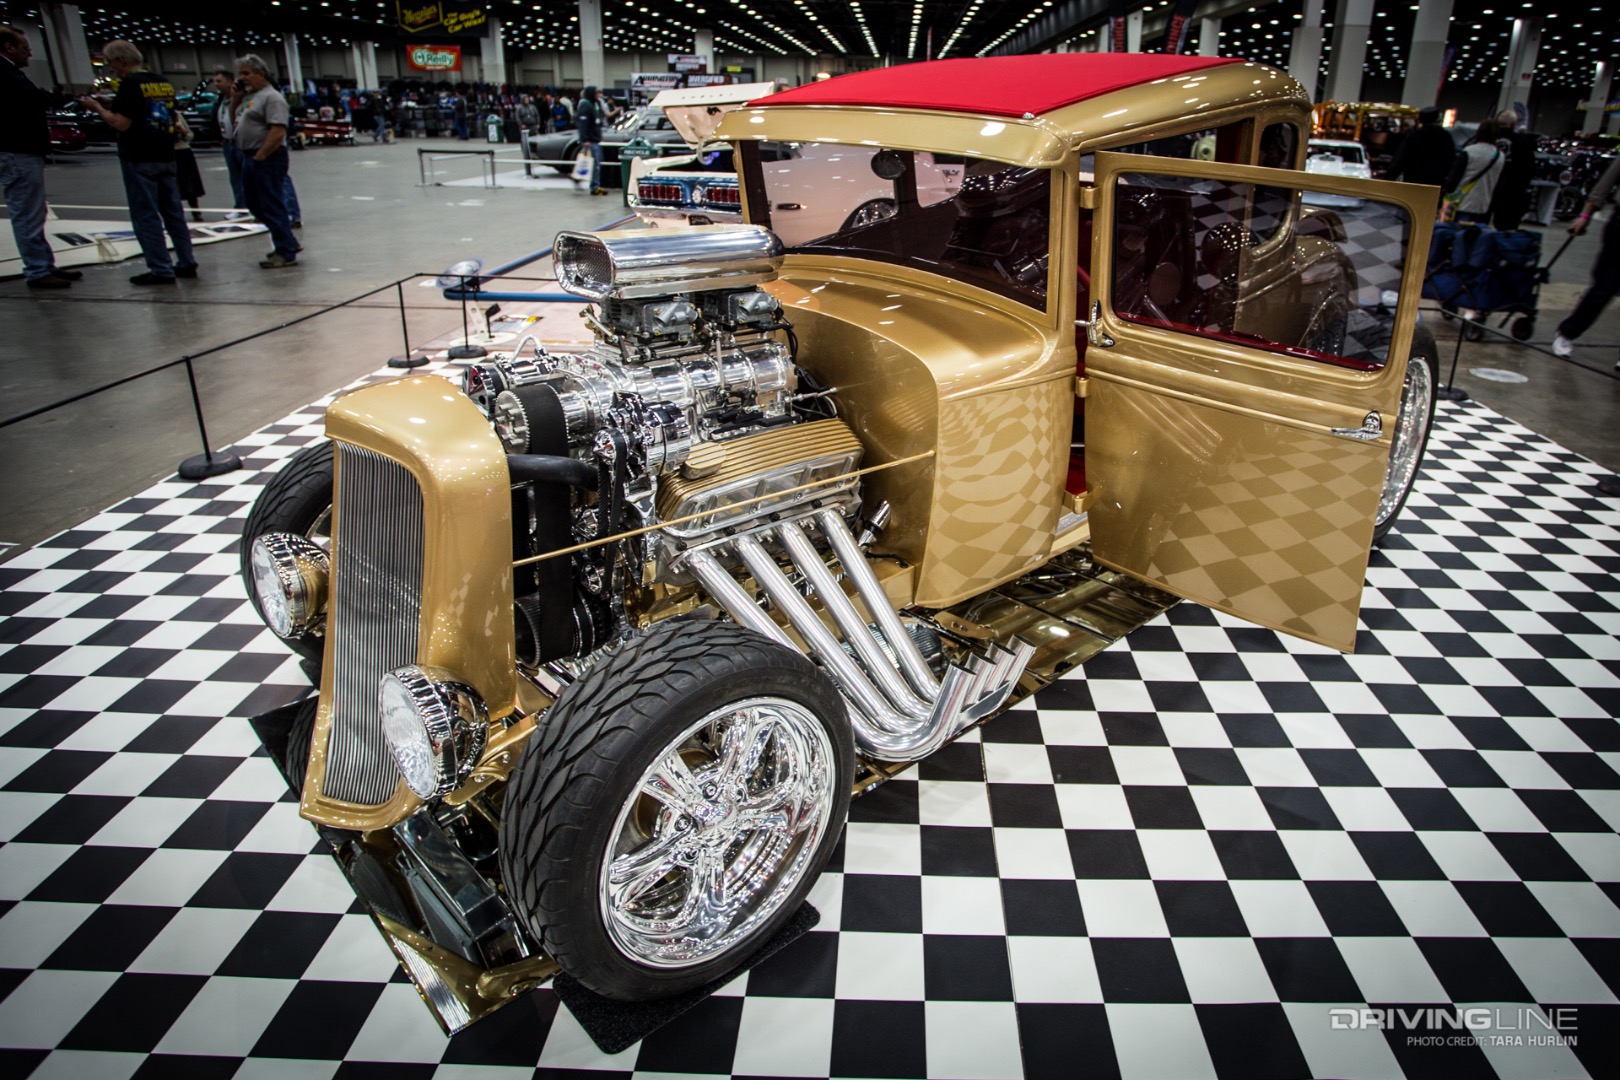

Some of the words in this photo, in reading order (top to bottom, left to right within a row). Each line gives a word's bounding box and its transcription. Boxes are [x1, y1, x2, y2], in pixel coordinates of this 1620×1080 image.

[443, 17, 458, 27] Car
[459, 8, 481, 21] Guy's
[448, 23, 463, 33] Car
[413, 49, 454, 67] O'Reilly
